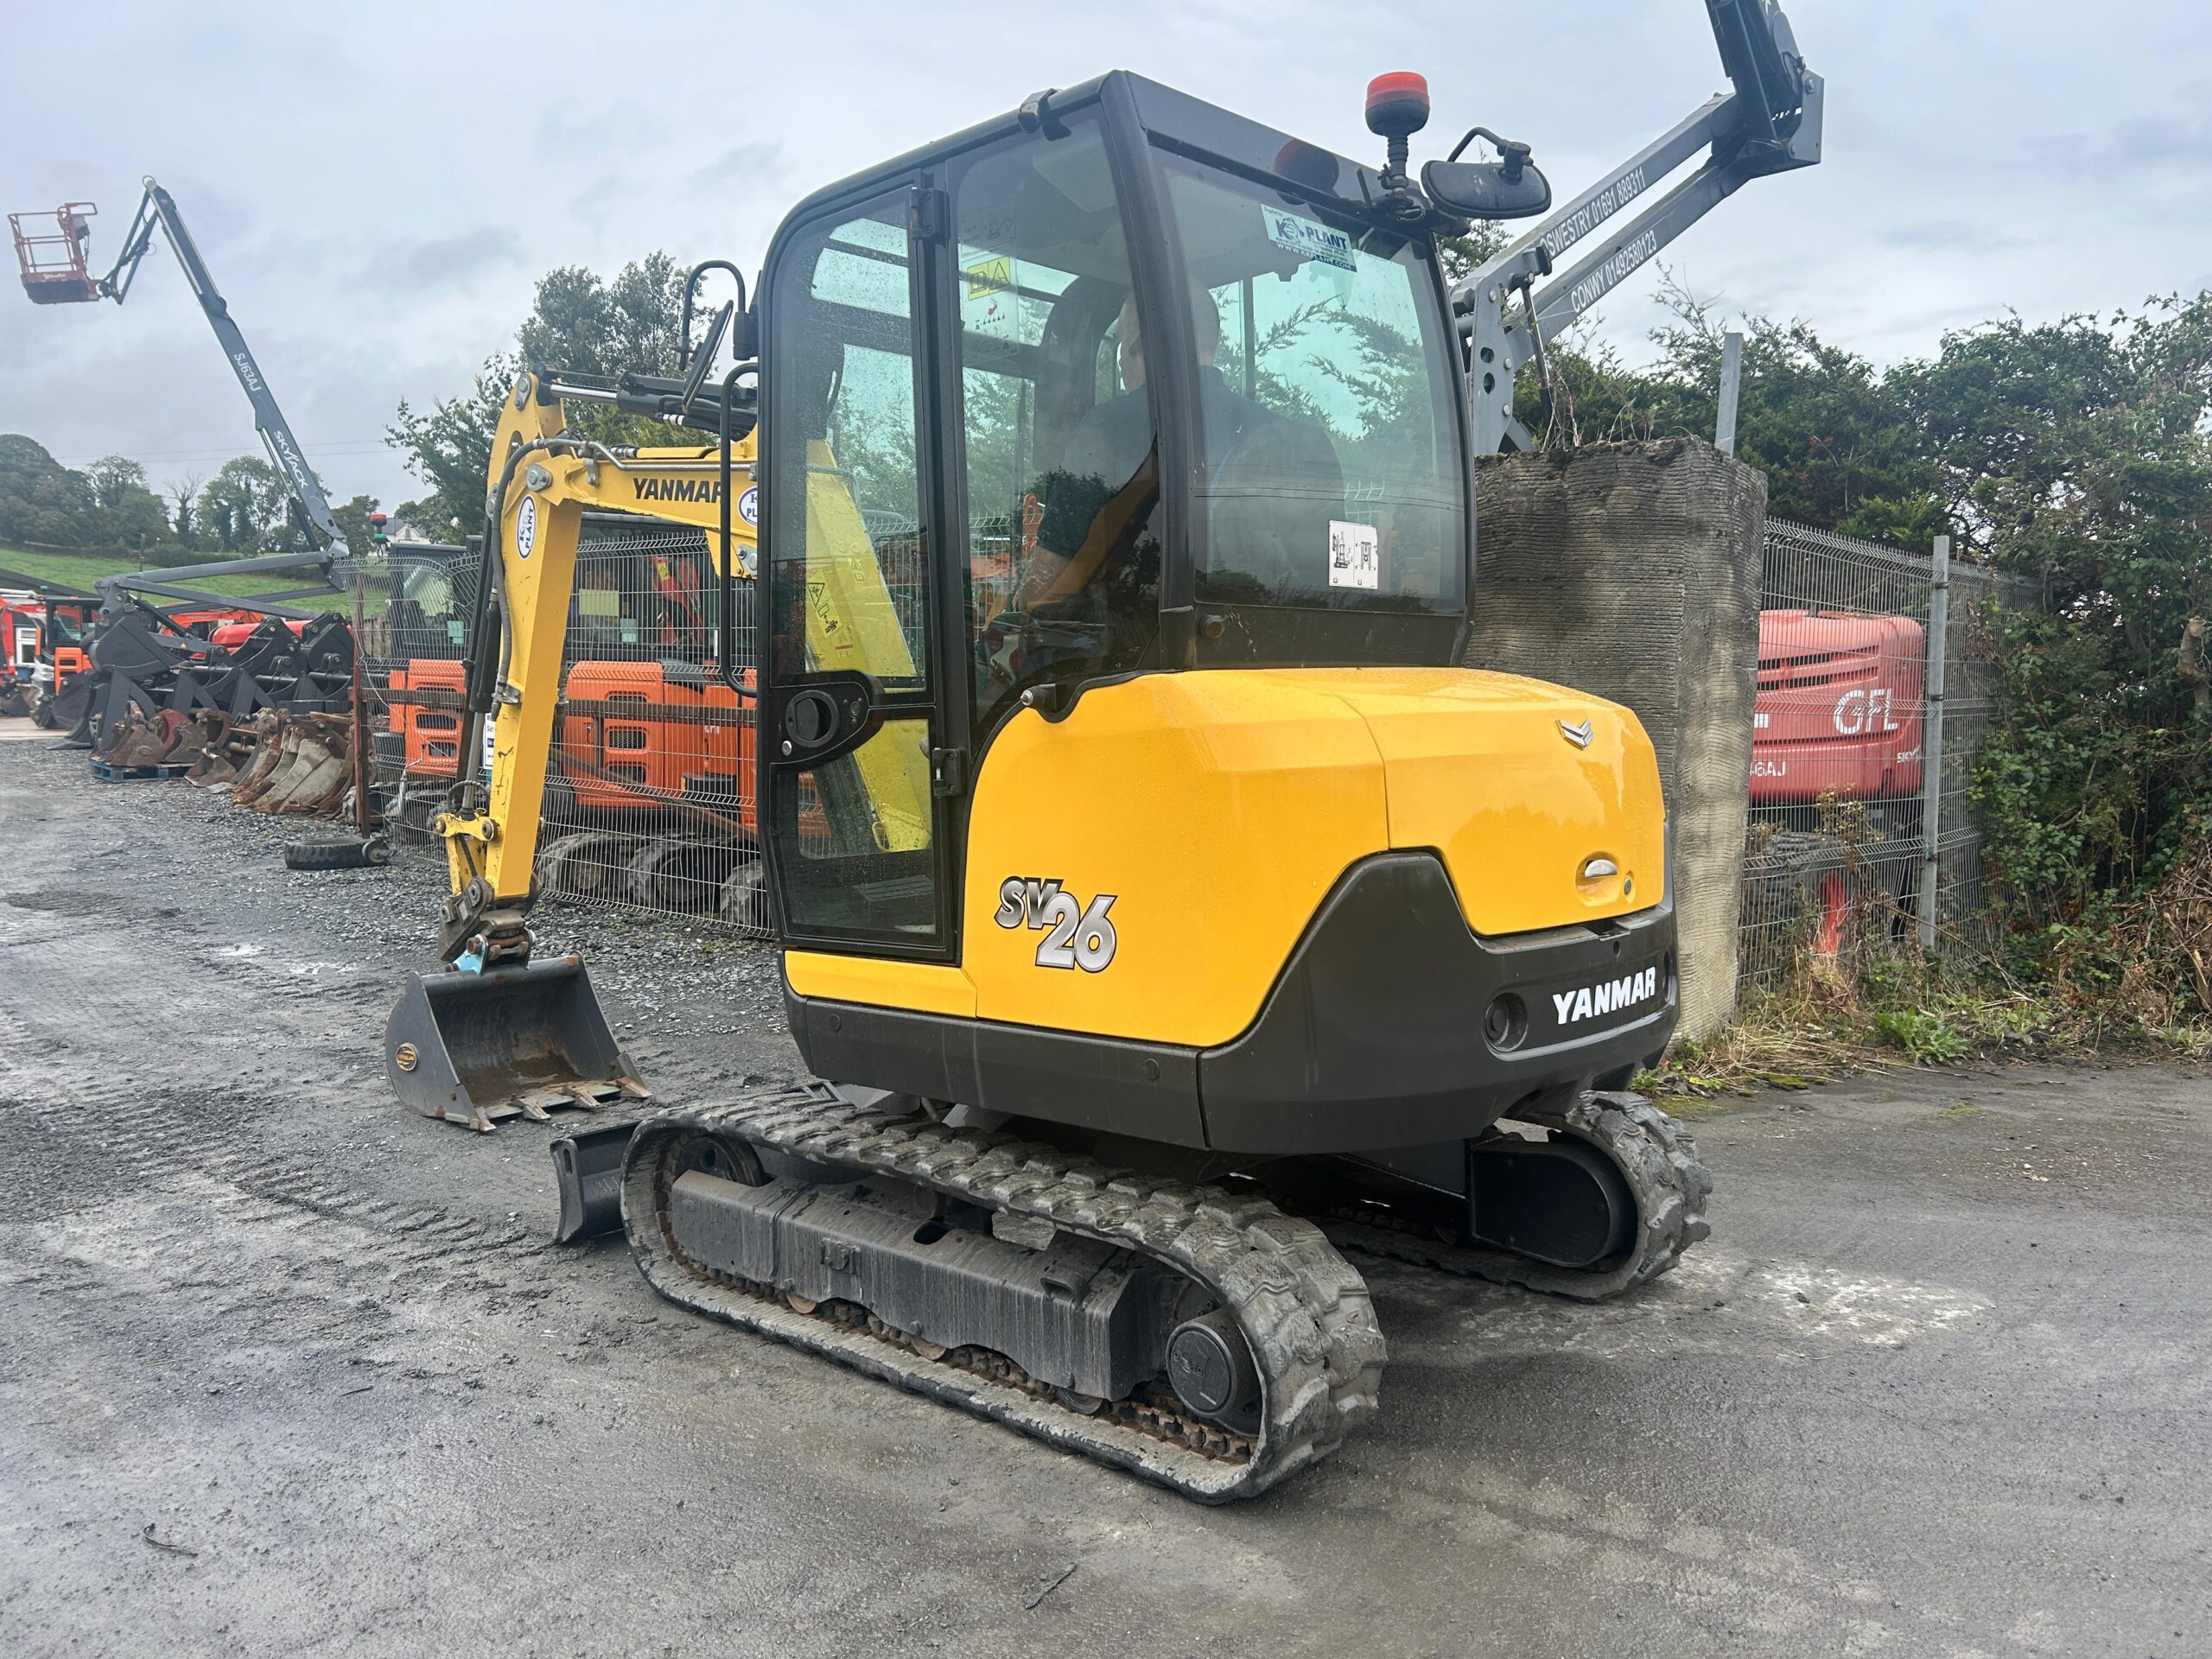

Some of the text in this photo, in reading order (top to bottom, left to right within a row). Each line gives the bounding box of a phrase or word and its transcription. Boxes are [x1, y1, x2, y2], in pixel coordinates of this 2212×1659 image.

[1591, 187, 1618, 224] 01691
[1616, 165, 1646, 205] 889311
[1305, 226, 1347, 250] PLANT
[1571, 229, 1657, 313] CONWY 01492580123
[233, 353, 262, 391] SJ63AJ
[274, 430, 308, 489] SKYJACK
[525, 505, 534, 549] PLANT
[1834, 689, 1899, 734] GFL
[1552, 966, 1656, 1025] YANMAR
